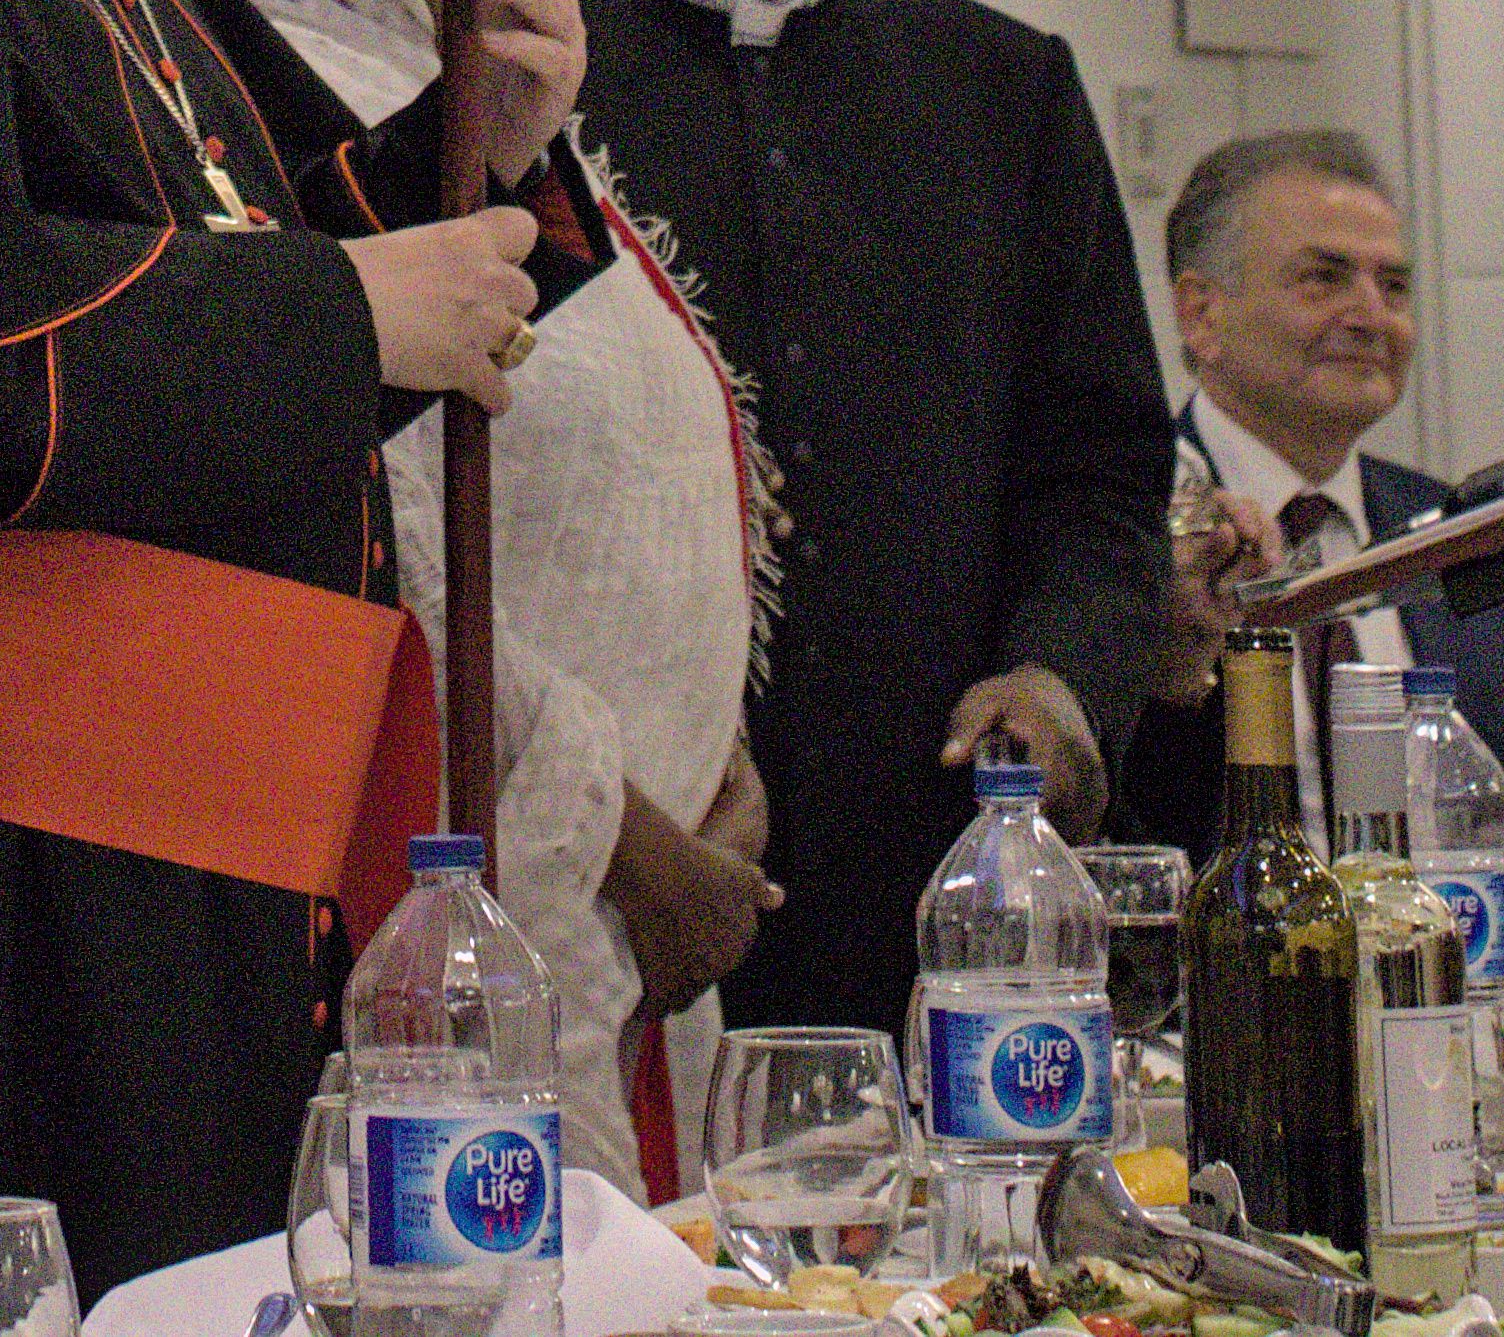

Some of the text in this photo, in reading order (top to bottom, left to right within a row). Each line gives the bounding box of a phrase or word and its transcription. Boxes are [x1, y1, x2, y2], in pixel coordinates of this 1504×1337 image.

[1008, 1033, 1072, 1062] Pure
[1018, 1061, 1065, 1092] Life
[466, 1143, 534, 1176] Pure
[476, 1177, 527, 1211] Life
